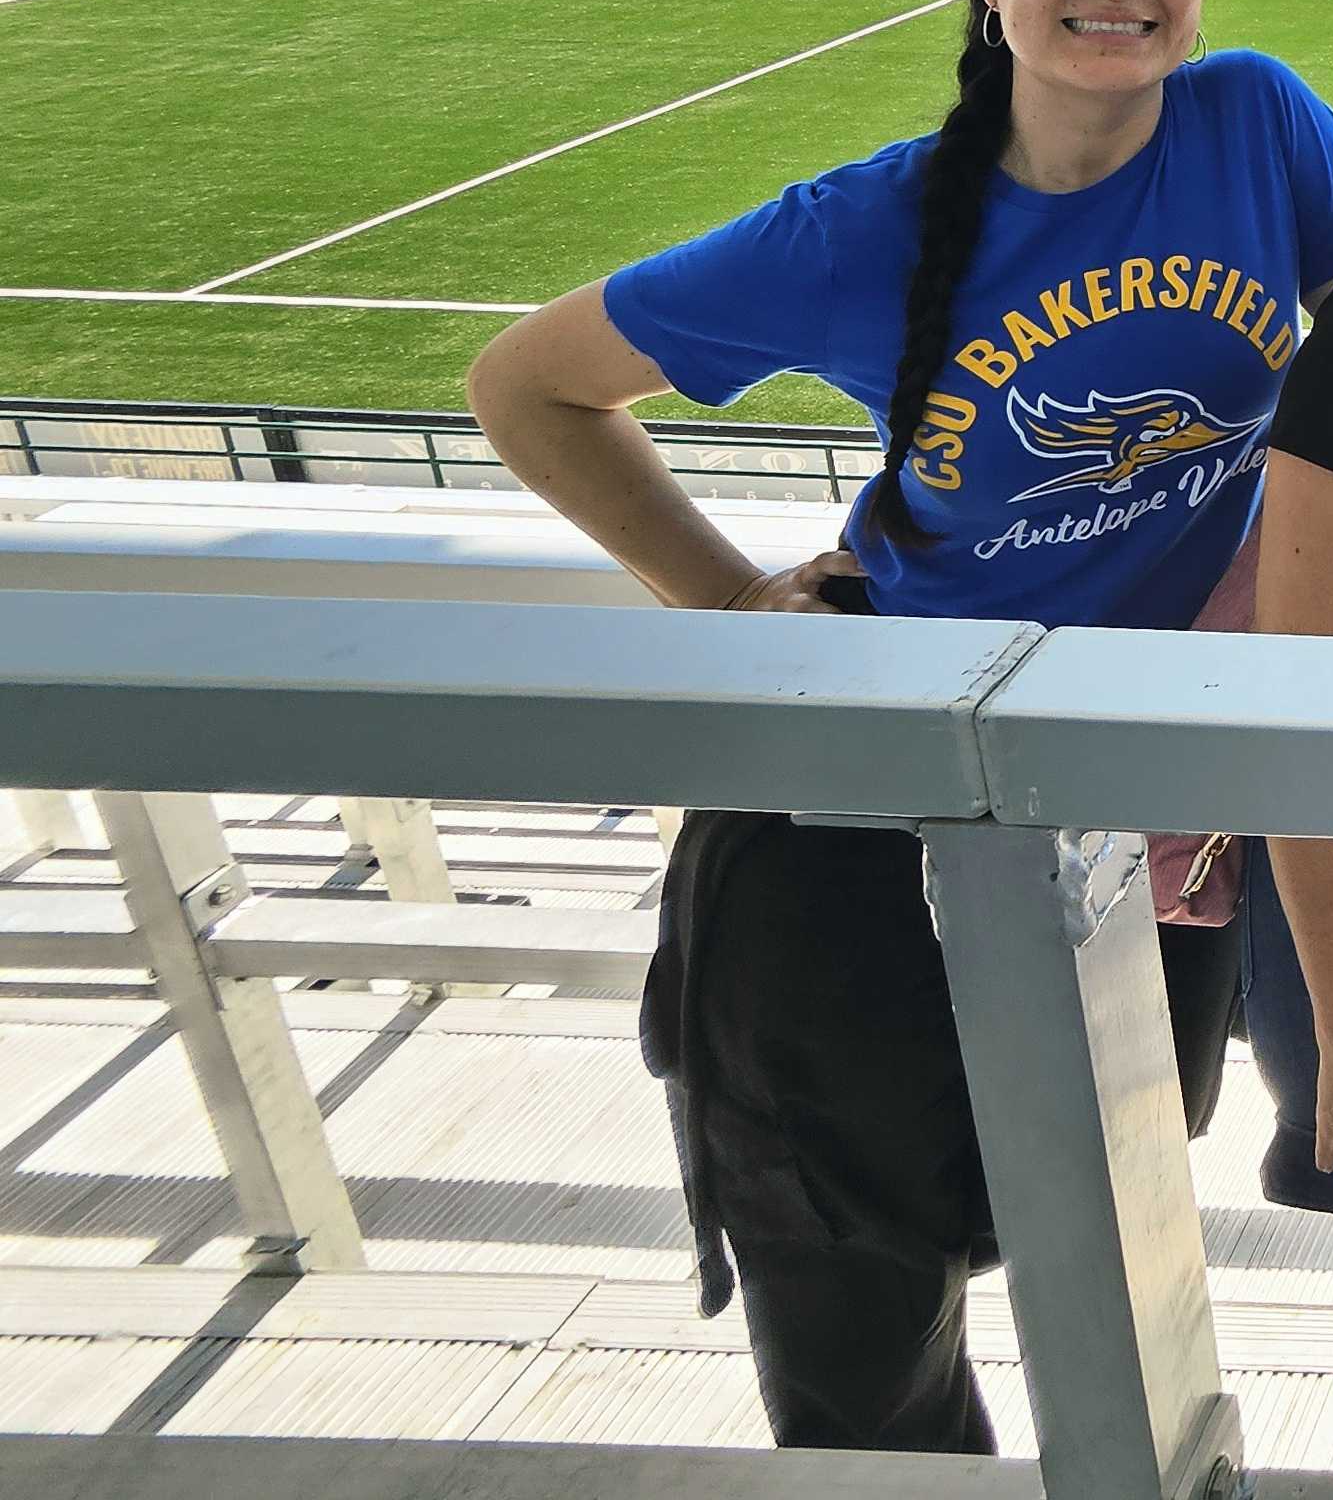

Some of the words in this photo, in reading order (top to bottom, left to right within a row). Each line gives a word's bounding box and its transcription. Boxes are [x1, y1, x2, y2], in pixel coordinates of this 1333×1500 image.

[911, 390, 977, 491] CSU
[954, 255, 1296, 389] BAKERSFIELD
[973, 488, 1168, 561] Antelope
